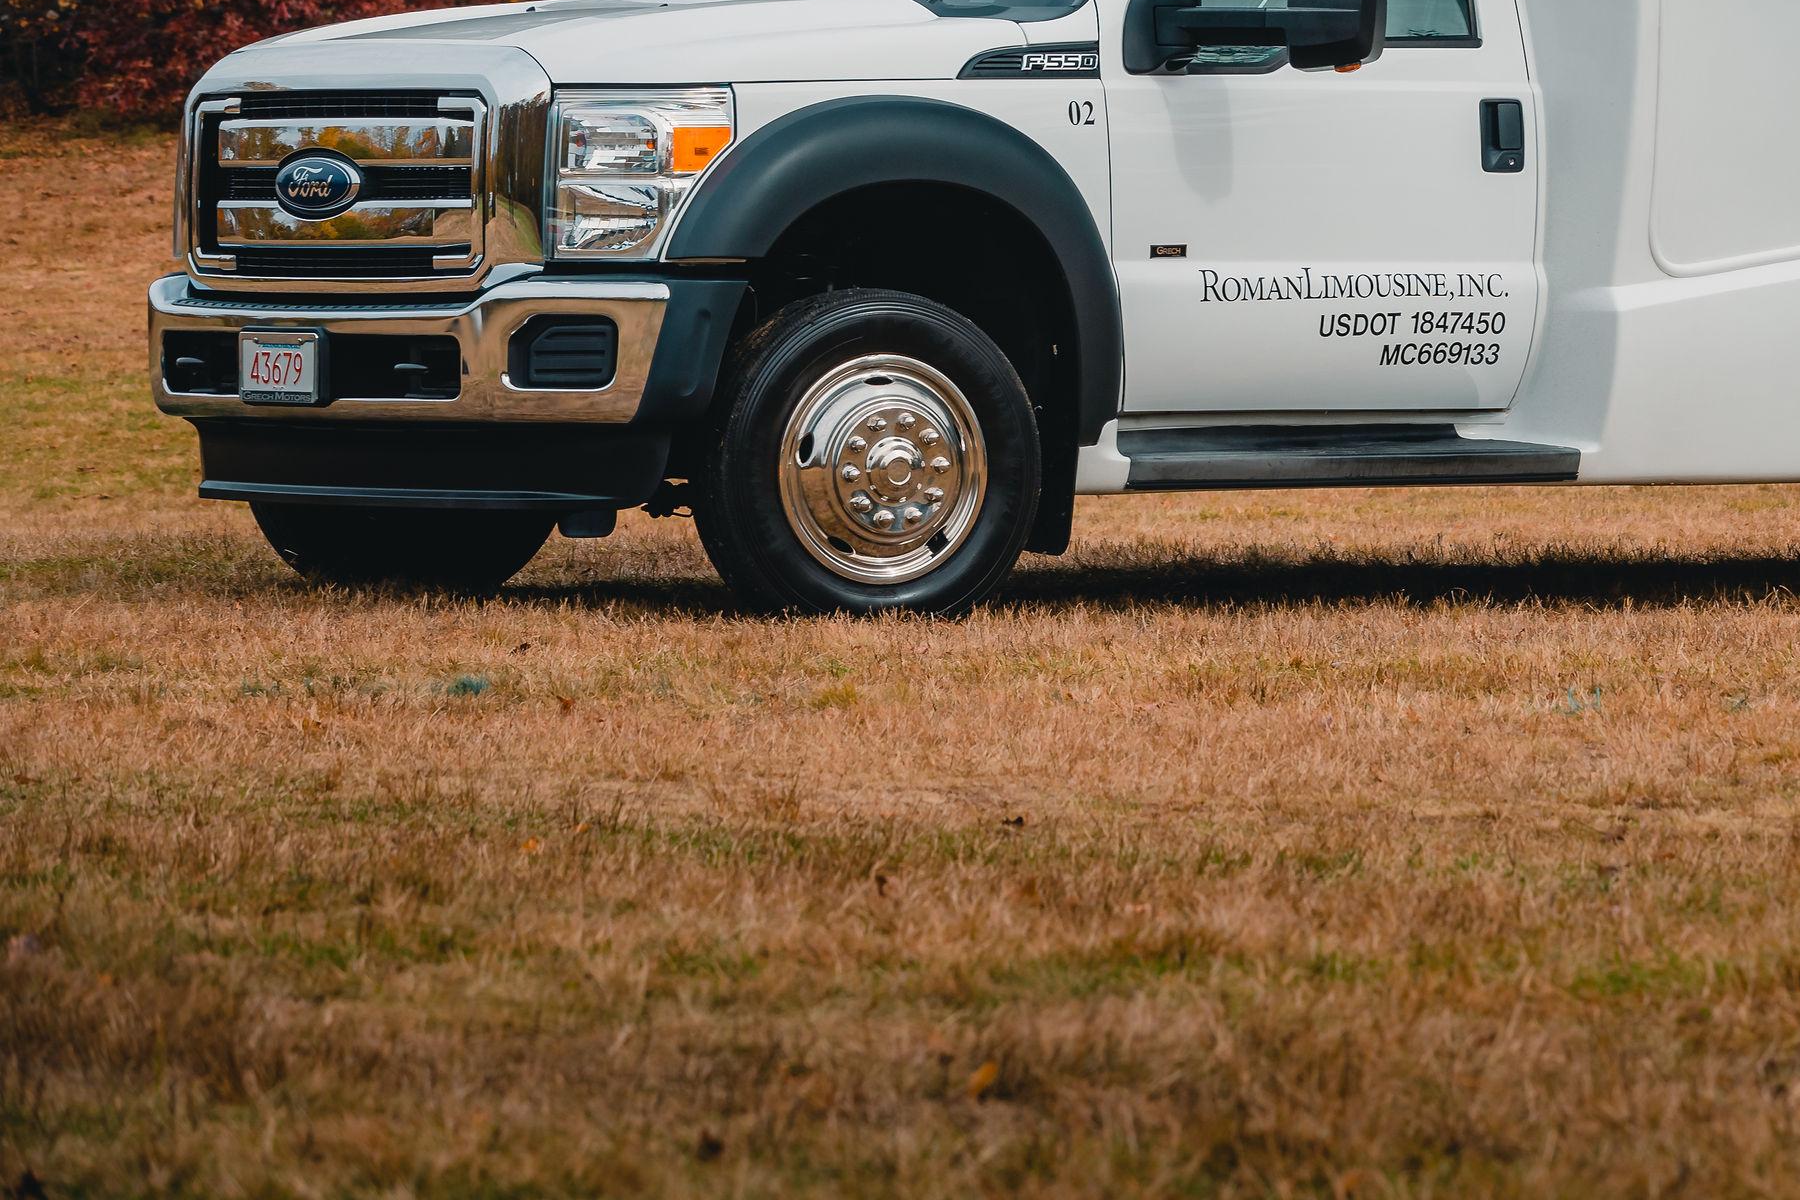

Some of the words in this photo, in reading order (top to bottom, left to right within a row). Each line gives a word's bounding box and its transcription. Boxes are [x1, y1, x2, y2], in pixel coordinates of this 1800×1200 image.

[1068, 100, 1096, 126] 02
[287, 166, 334, 198] Ford
[1319, 312, 1401, 337] USDOT
[1410, 311, 1506, 335] 1847450
[1379, 342, 1500, 366] MC669133
[250, 351, 303, 385] 43679
